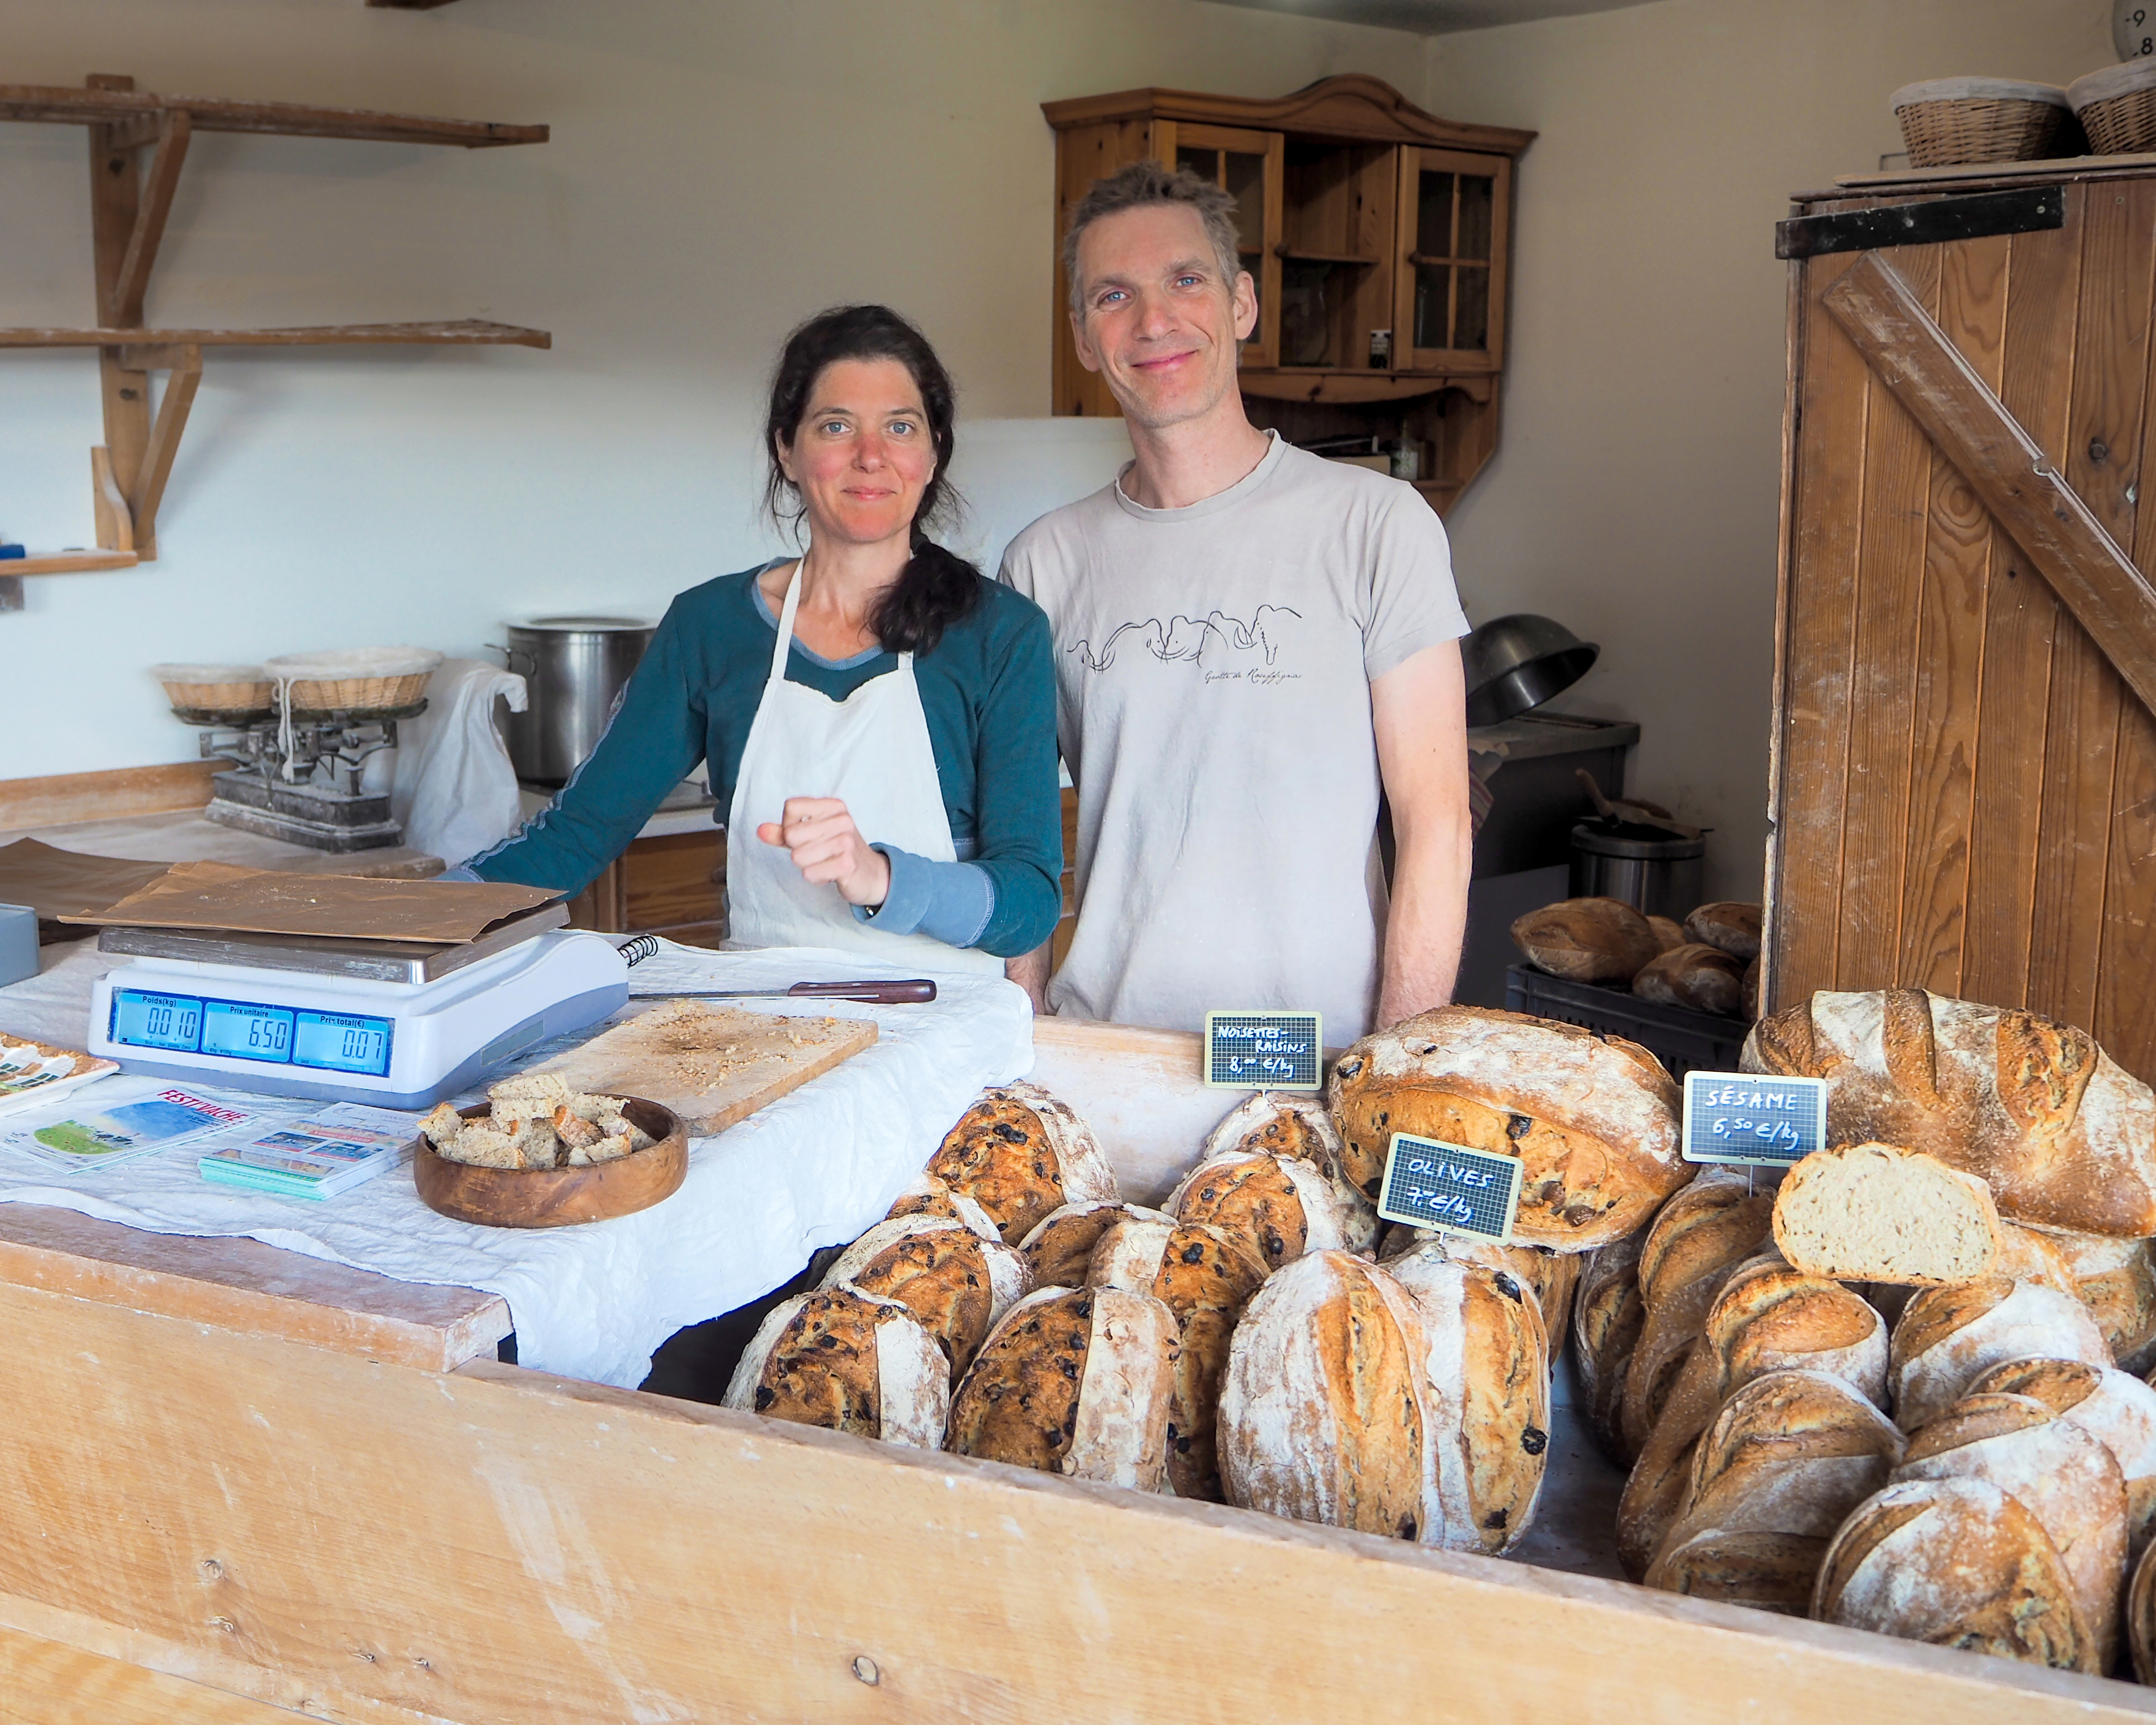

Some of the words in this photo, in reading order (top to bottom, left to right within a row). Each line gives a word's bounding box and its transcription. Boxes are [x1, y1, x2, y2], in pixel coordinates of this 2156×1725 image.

[2133, 9, 2146, 28] 9
[2141, 37, 2153, 55] 8
[142, 996, 177, 1007] Poids(kg)
[147, 1007, 197, 1039] 0.010
[244, 1009, 269, 1017] unitaire
[320, 1015, 335, 1024] Prix
[337, 1018, 365, 1029] total(€)
[248, 1018, 287, 1050] 6.50
[342, 1029, 382, 1060] 0.07
[1254, 1039, 1307, 1053] RAISINS
[157, 1089, 249, 1121] FESTI'VACHE
[1705, 1085, 1798, 1111] SÉSAME
[1407, 1158, 1494, 1188] OLIVES
